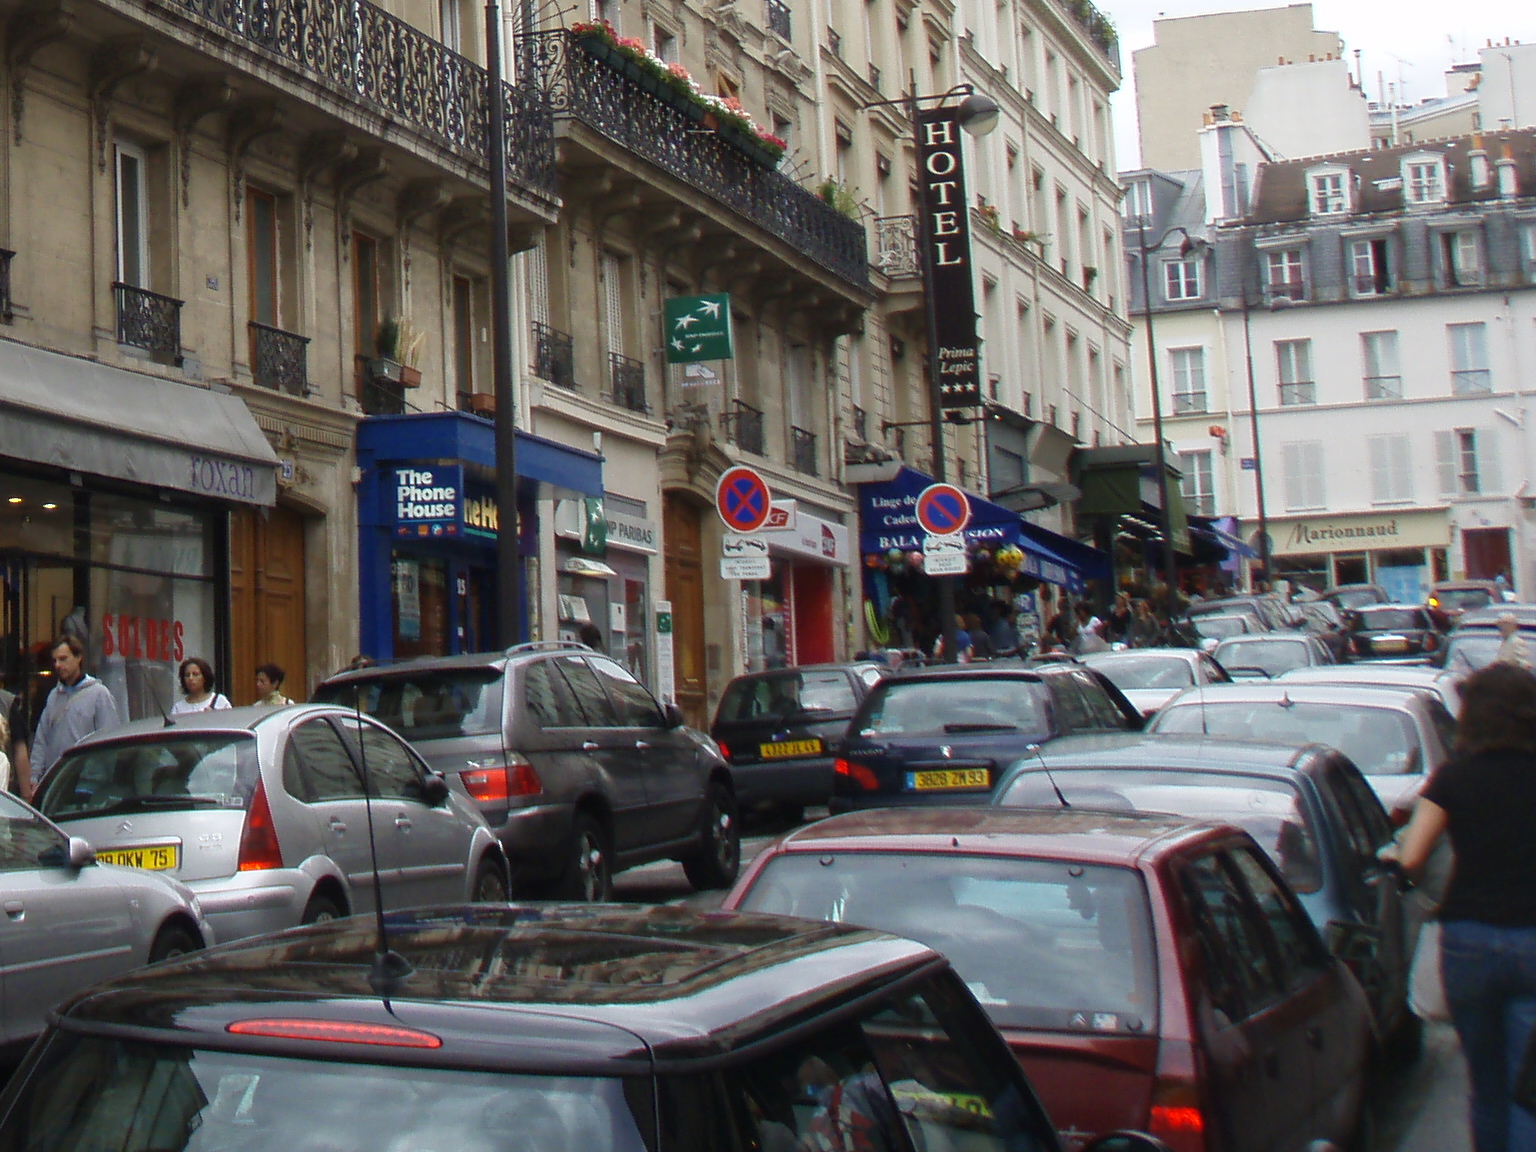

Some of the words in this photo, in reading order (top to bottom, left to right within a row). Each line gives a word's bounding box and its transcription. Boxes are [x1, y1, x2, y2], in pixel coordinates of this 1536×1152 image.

[923, 120, 962, 266] HOTEL
[938, 347, 974, 359] Prima
[941, 360, 974, 375] Lepic
[190, 455, 255, 499] roxan
[396, 469, 433, 485] The
[397, 486, 456, 502] Phone
[398, 502, 456, 519] House
[872, 497, 902, 509] Linge
[883, 514, 917, 526] Cadea
[619, 522, 653, 544] PARIBAS
[1286, 520, 1399, 549] Marionnaud
[879, 536, 919, 548] BALA
[102, 613, 184, 662] SOLDES
[150, 849, 168, 866] 75
